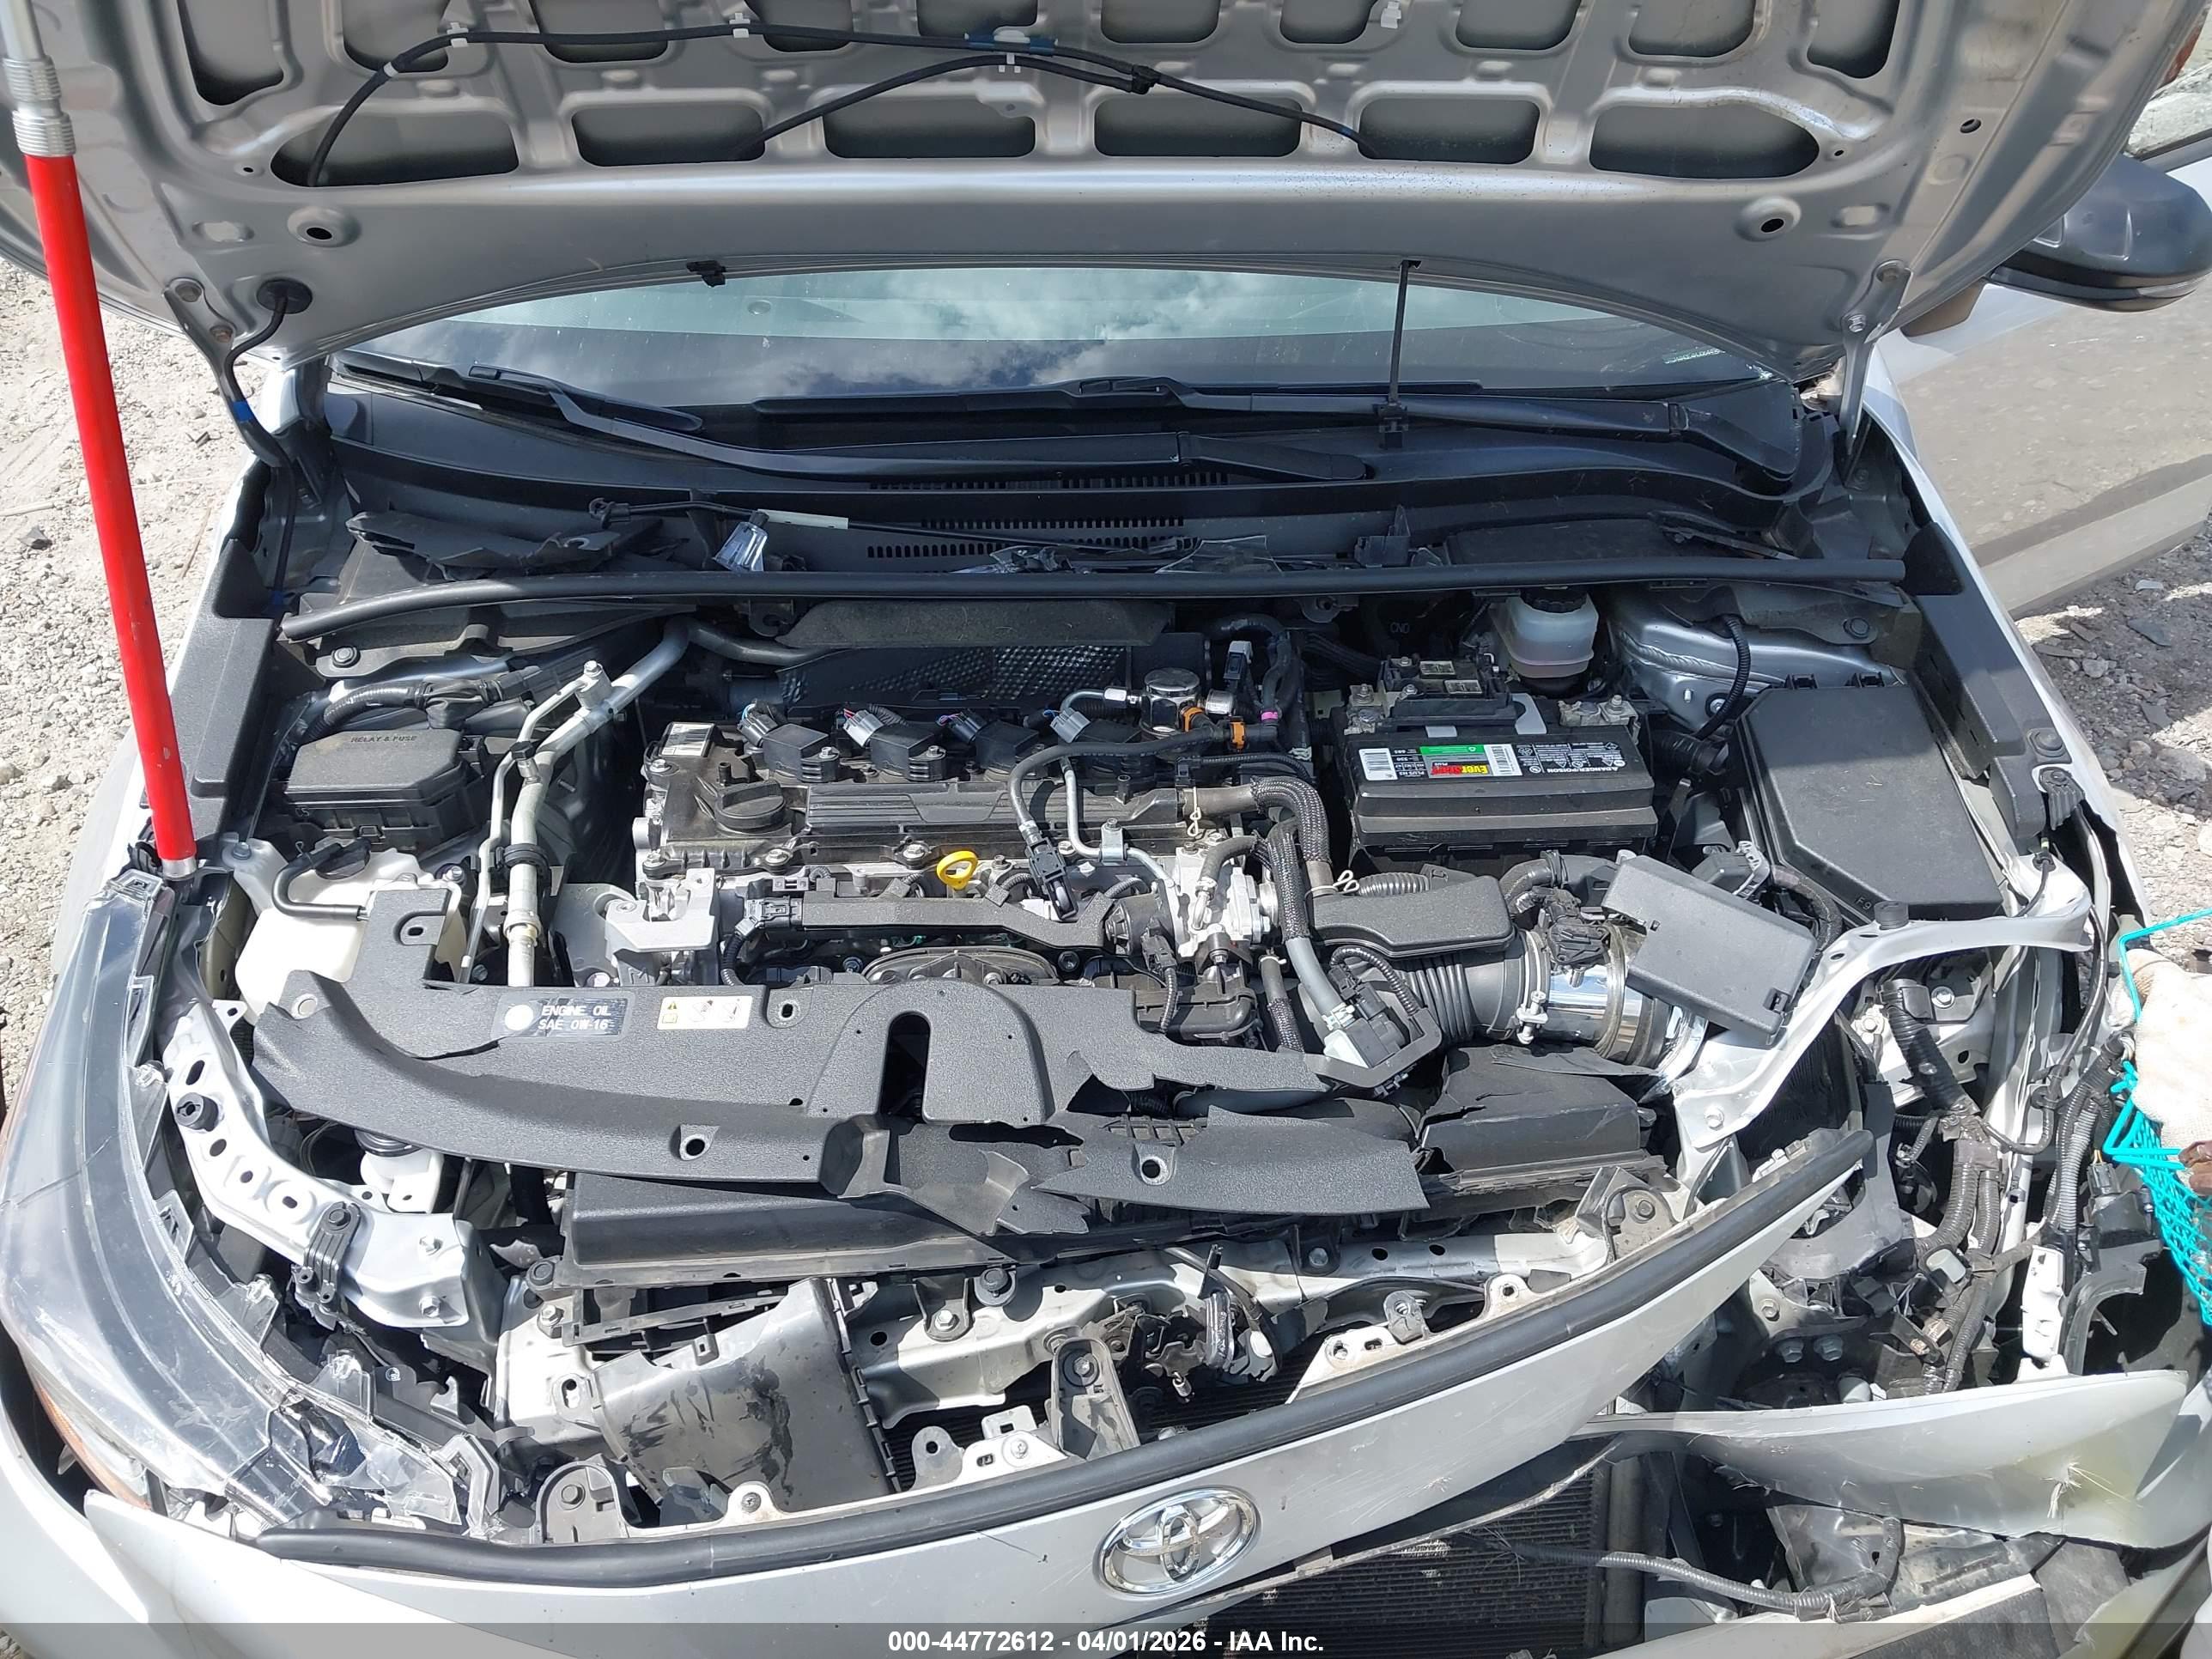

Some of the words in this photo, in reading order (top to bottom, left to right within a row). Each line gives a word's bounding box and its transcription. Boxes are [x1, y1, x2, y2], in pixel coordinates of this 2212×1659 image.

[1430, 765, 1488, 776] EverStart
[1855, 896, 1873, 910] F9
[541, 1005, 586, 1017] ENGINE
[592, 1005, 612, 1016] OIL
[538, 1018, 563, 1030] SAE
